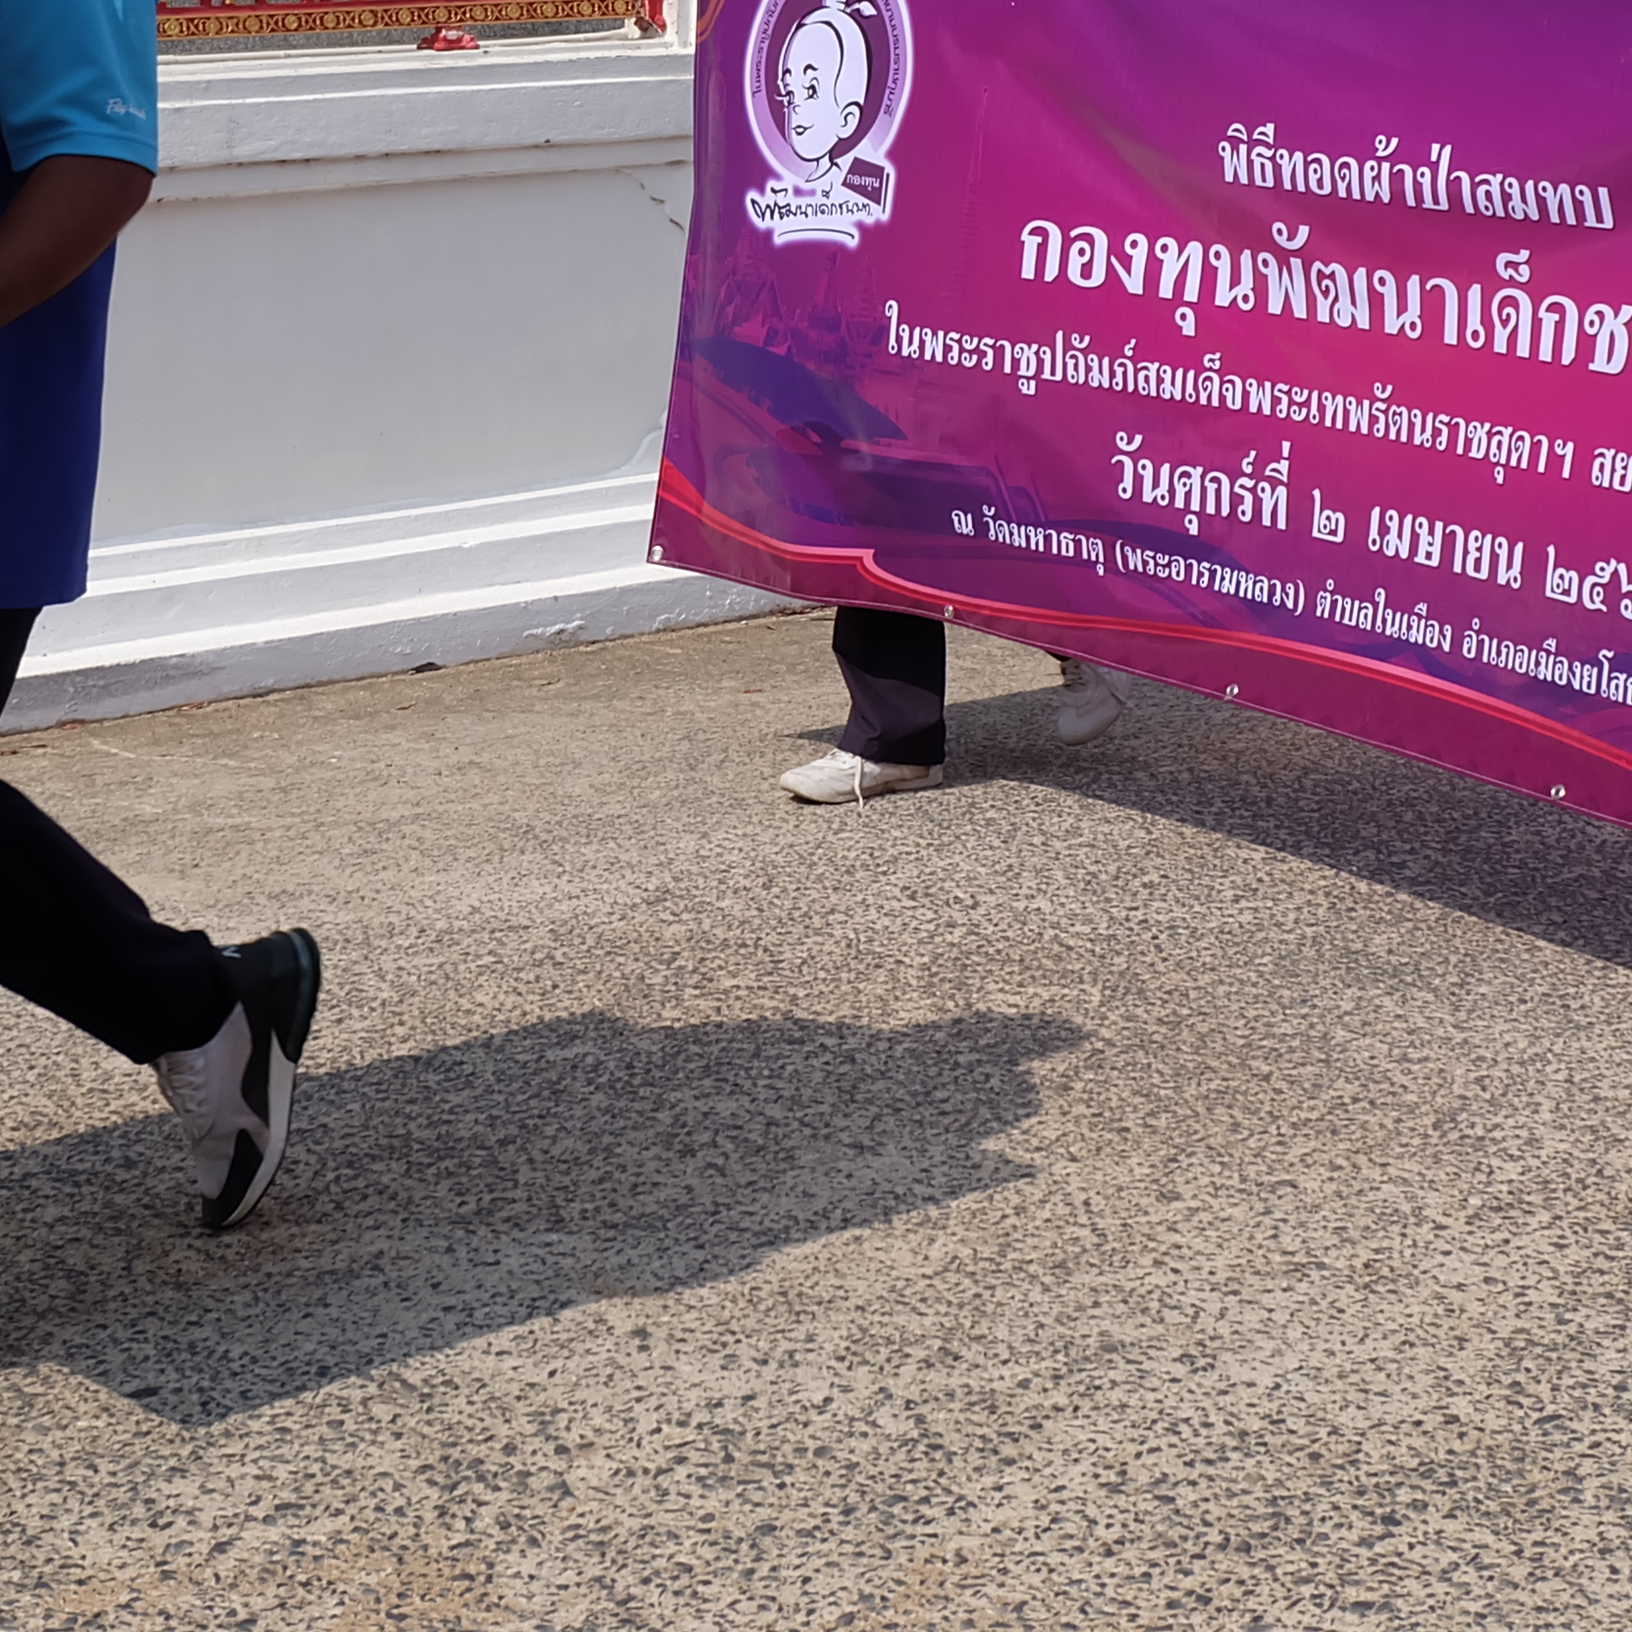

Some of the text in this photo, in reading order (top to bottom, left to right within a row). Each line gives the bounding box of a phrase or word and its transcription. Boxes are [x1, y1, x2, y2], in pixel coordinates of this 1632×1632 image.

[846, 173, 881, 192] กองทุน
[1218, 122, 1615, 230] พิธีทอดผ้าป่าสมทบ
[885, 300, 1575, 486] ในพระราชูปถัมภ์สมเด็จพระเทพรัตนราชสุดาฯ
[951, 508, 975, 537] ณ
[982, 505, 1105, 576] วัดมหาธาตุ
[1115, 539, 1305, 616] (พระอารามหลวง)
[1315, 579, 1452, 653] ตำบลในเมือง
[1111, 431, 1291, 536] วันศุกร์ที่
[1311, 488, 1345, 544] ๒
[1368, 505, 1524, 589] เมษายน
